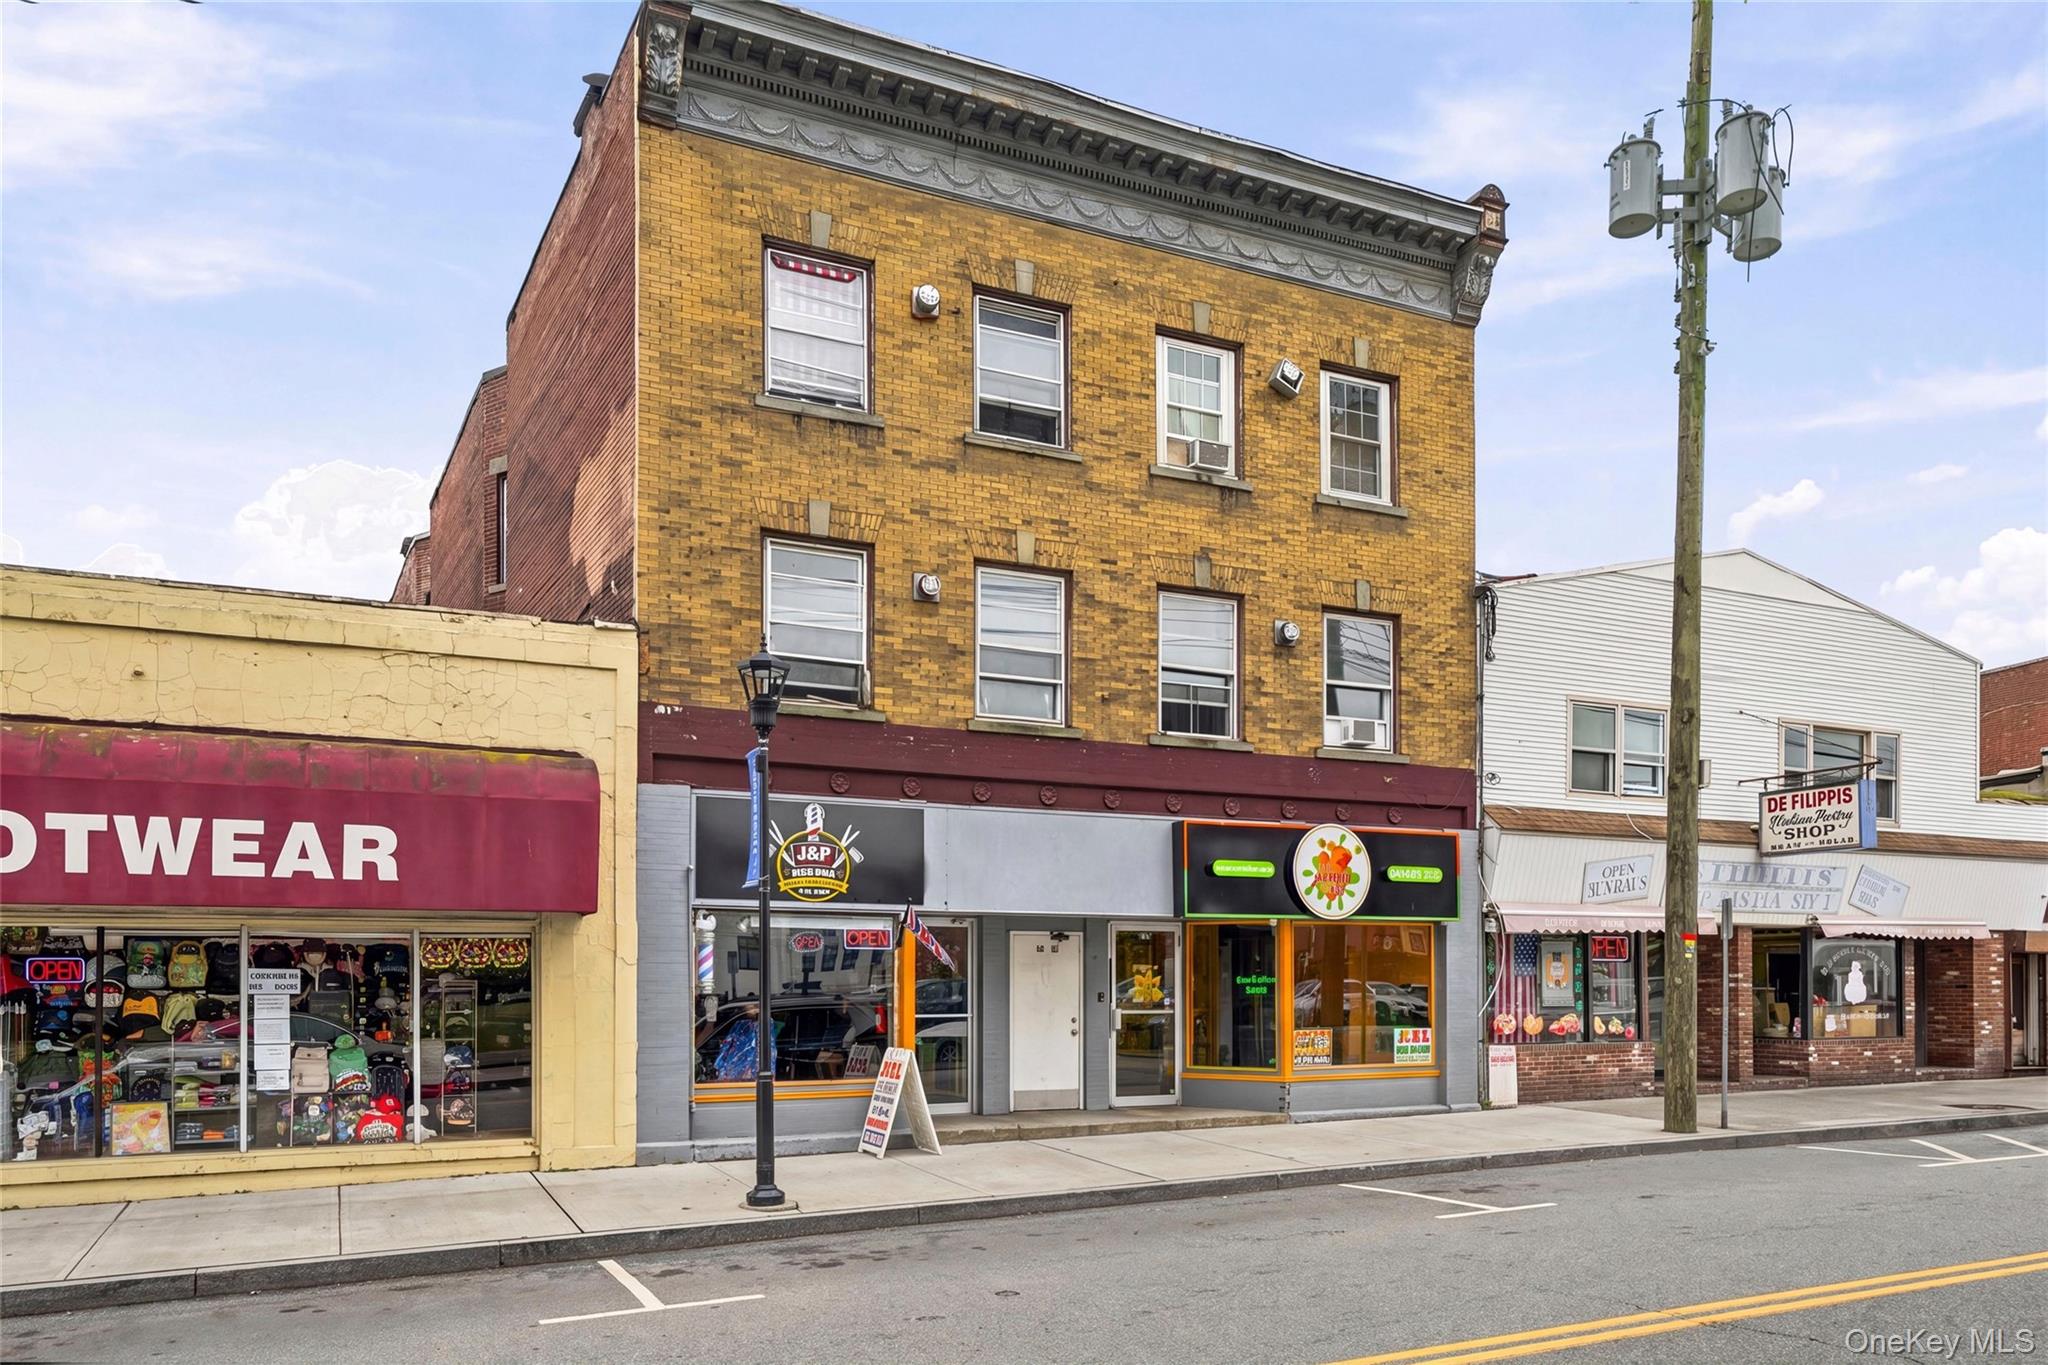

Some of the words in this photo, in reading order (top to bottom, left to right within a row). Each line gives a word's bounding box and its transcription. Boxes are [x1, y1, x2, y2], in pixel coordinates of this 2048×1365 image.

[1767, 796, 1787, 813] DE
[1792, 787, 1853, 810] FILIPPIS
[1784, 824, 1836, 840] SHOP
[796, 845, 831, 861] J&P
[1602, 862, 1635, 879] OPEN
[848, 930, 888, 946] OPEN
[30, 960, 82, 981] OPEN
